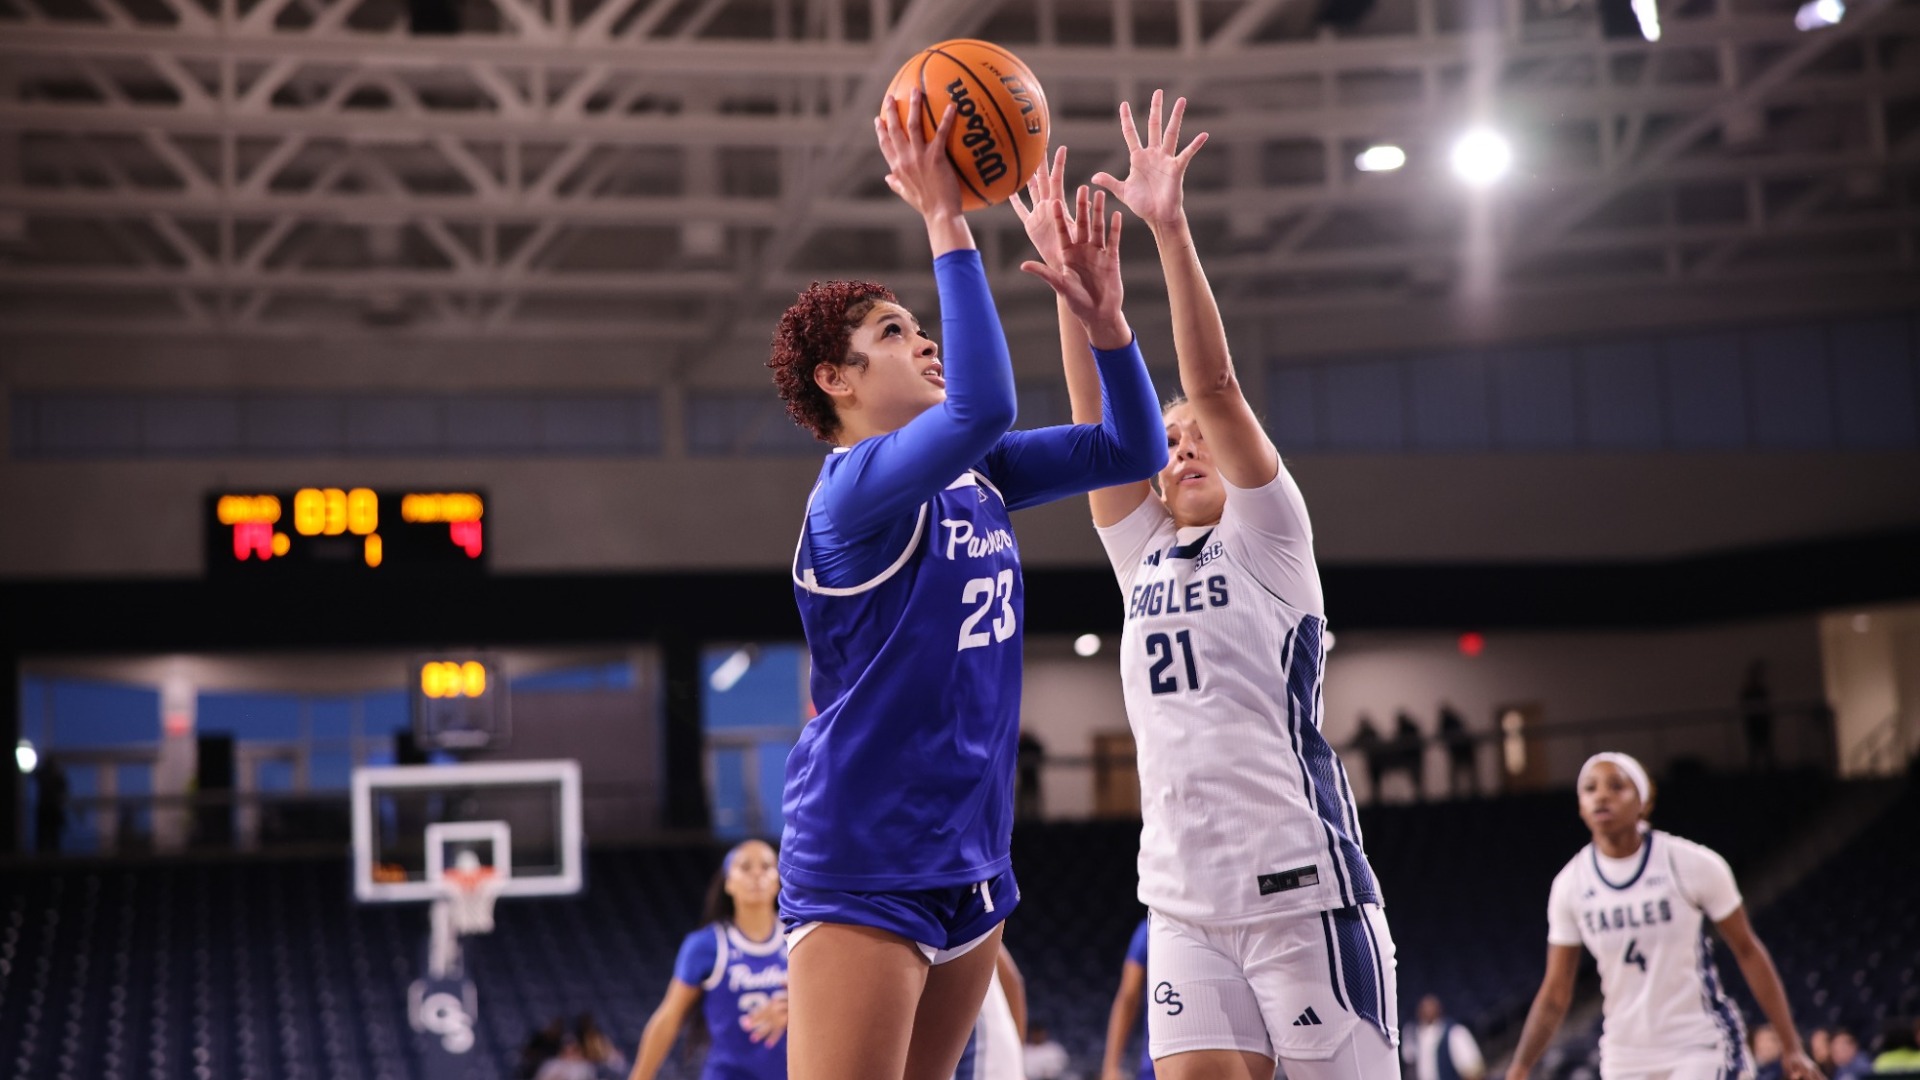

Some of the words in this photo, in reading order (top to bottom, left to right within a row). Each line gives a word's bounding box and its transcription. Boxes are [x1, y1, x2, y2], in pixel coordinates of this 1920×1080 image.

[945, 77, 1008, 187] Wilson
[957, 568, 1016, 652] 23
[1129, 574, 1230, 620] EAGLES
[1145, 629, 1200, 695] 21
[1584, 898, 1672, 933] EAGLES
[1624, 938, 1647, 973] 4
[1154, 981, 1184, 1016] GS
